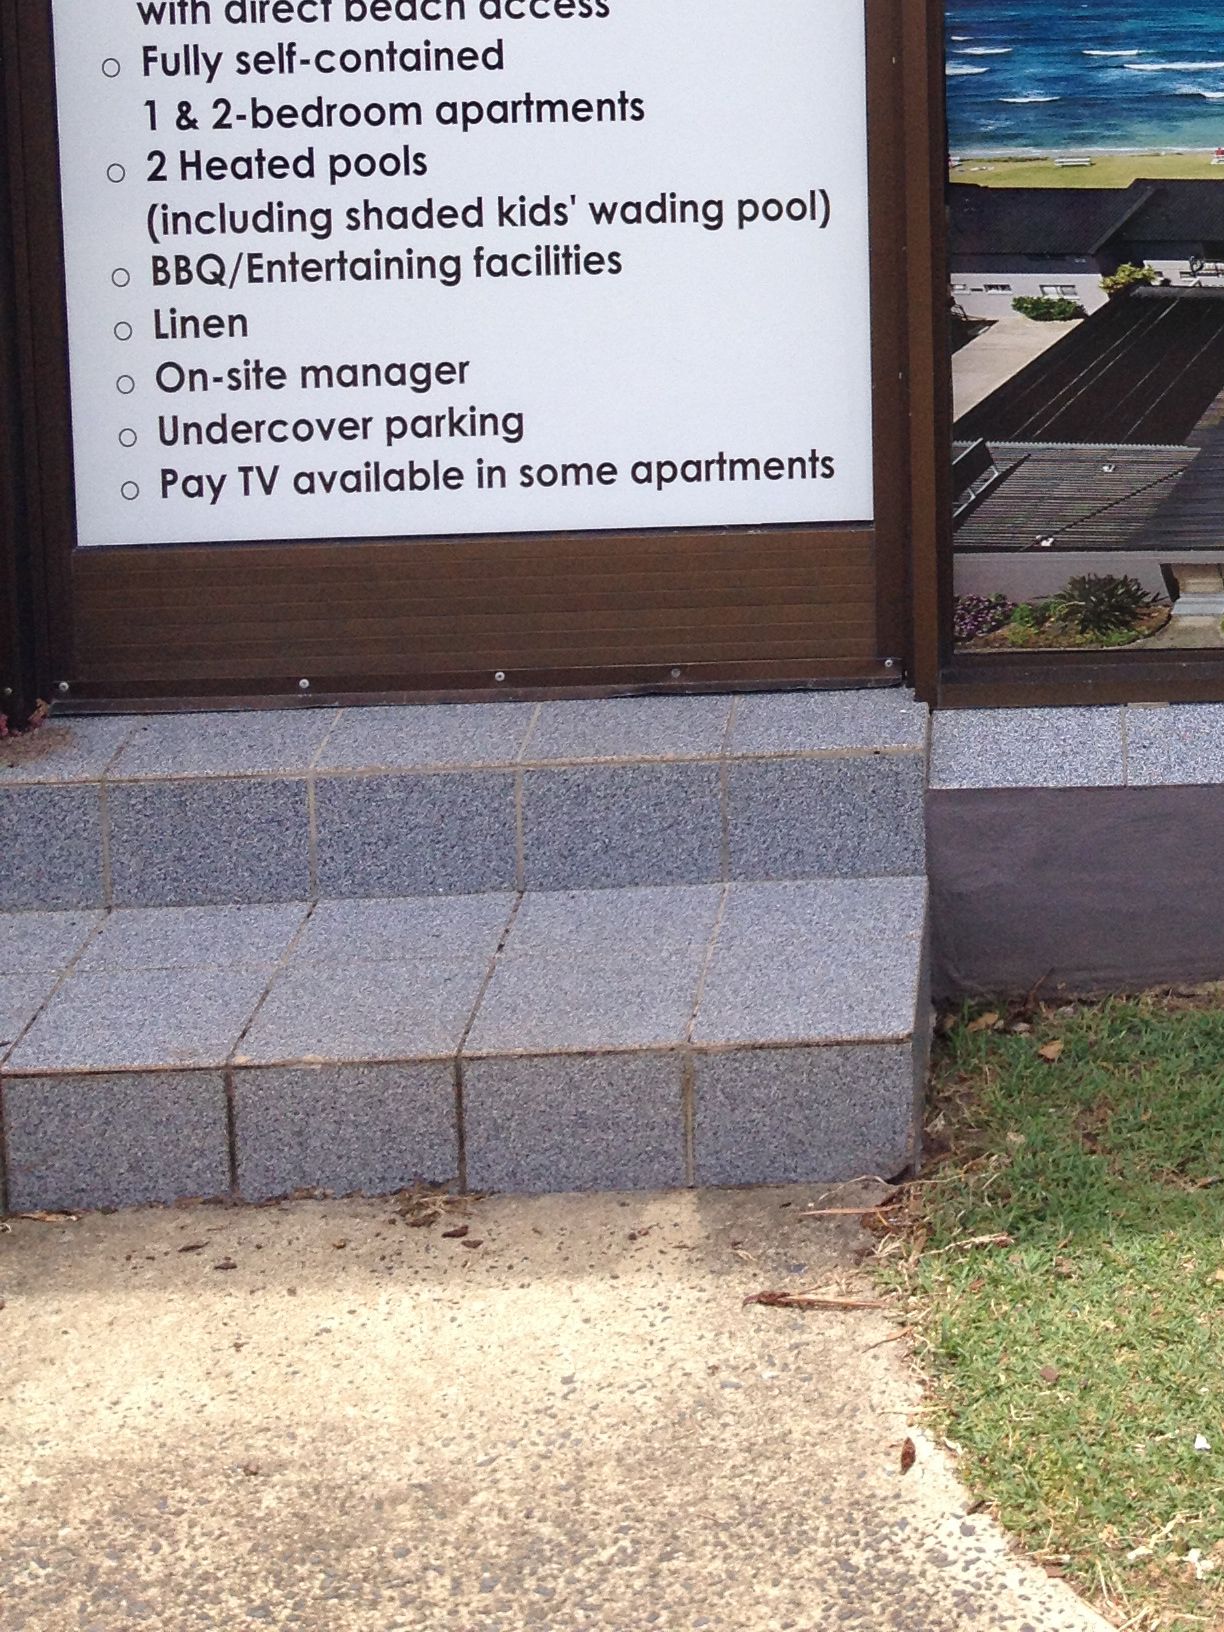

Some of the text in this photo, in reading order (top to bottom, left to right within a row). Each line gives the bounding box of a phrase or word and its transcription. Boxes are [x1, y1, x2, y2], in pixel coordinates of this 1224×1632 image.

[142, 38, 504, 83] Fully self-contained
[144, 90, 645, 132] 1 & 2-bedroom apartments
[147, 145, 427, 185] 2 Heated pools
[147, 189, 830, 244] (including shaded kids' wading pool)
[152, 244, 622, 289] BBQ/Entertaining facilities
[154, 307, 248, 339] Linen
[156, 359, 470, 393] On-site manager
[158, 405, 523, 446] Undercover parking
[161, 449, 835, 505] Pay TV available in some apartments
